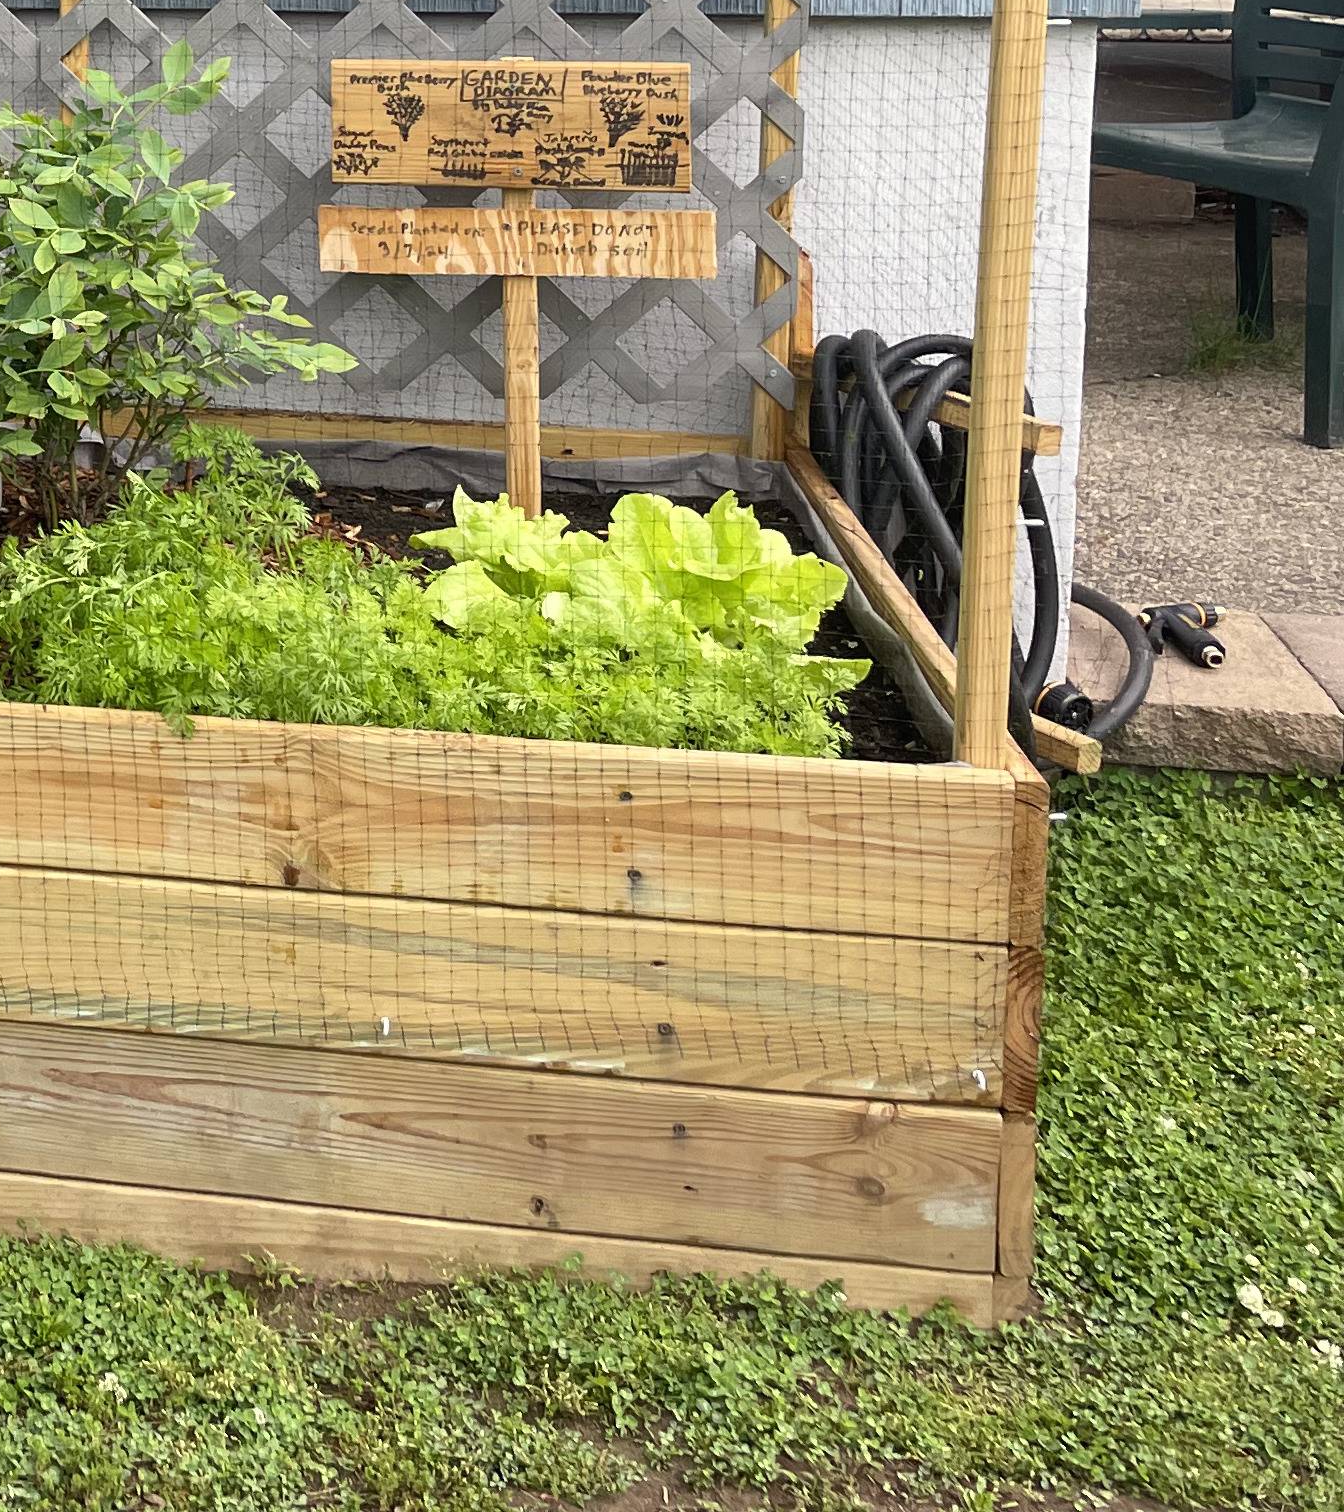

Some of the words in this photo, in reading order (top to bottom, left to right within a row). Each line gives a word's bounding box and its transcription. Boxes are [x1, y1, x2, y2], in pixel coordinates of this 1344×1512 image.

[464, 69, 553, 87] GARDEN
[636, 72, 672, 86] Blue
[473, 85, 557, 98] DIAGRAM
[401, 220, 460, 236] Planted
[517, 221, 585, 236] PLEASE
[591, 222, 614, 236] DO
[618, 224, 658, 238] NOT
